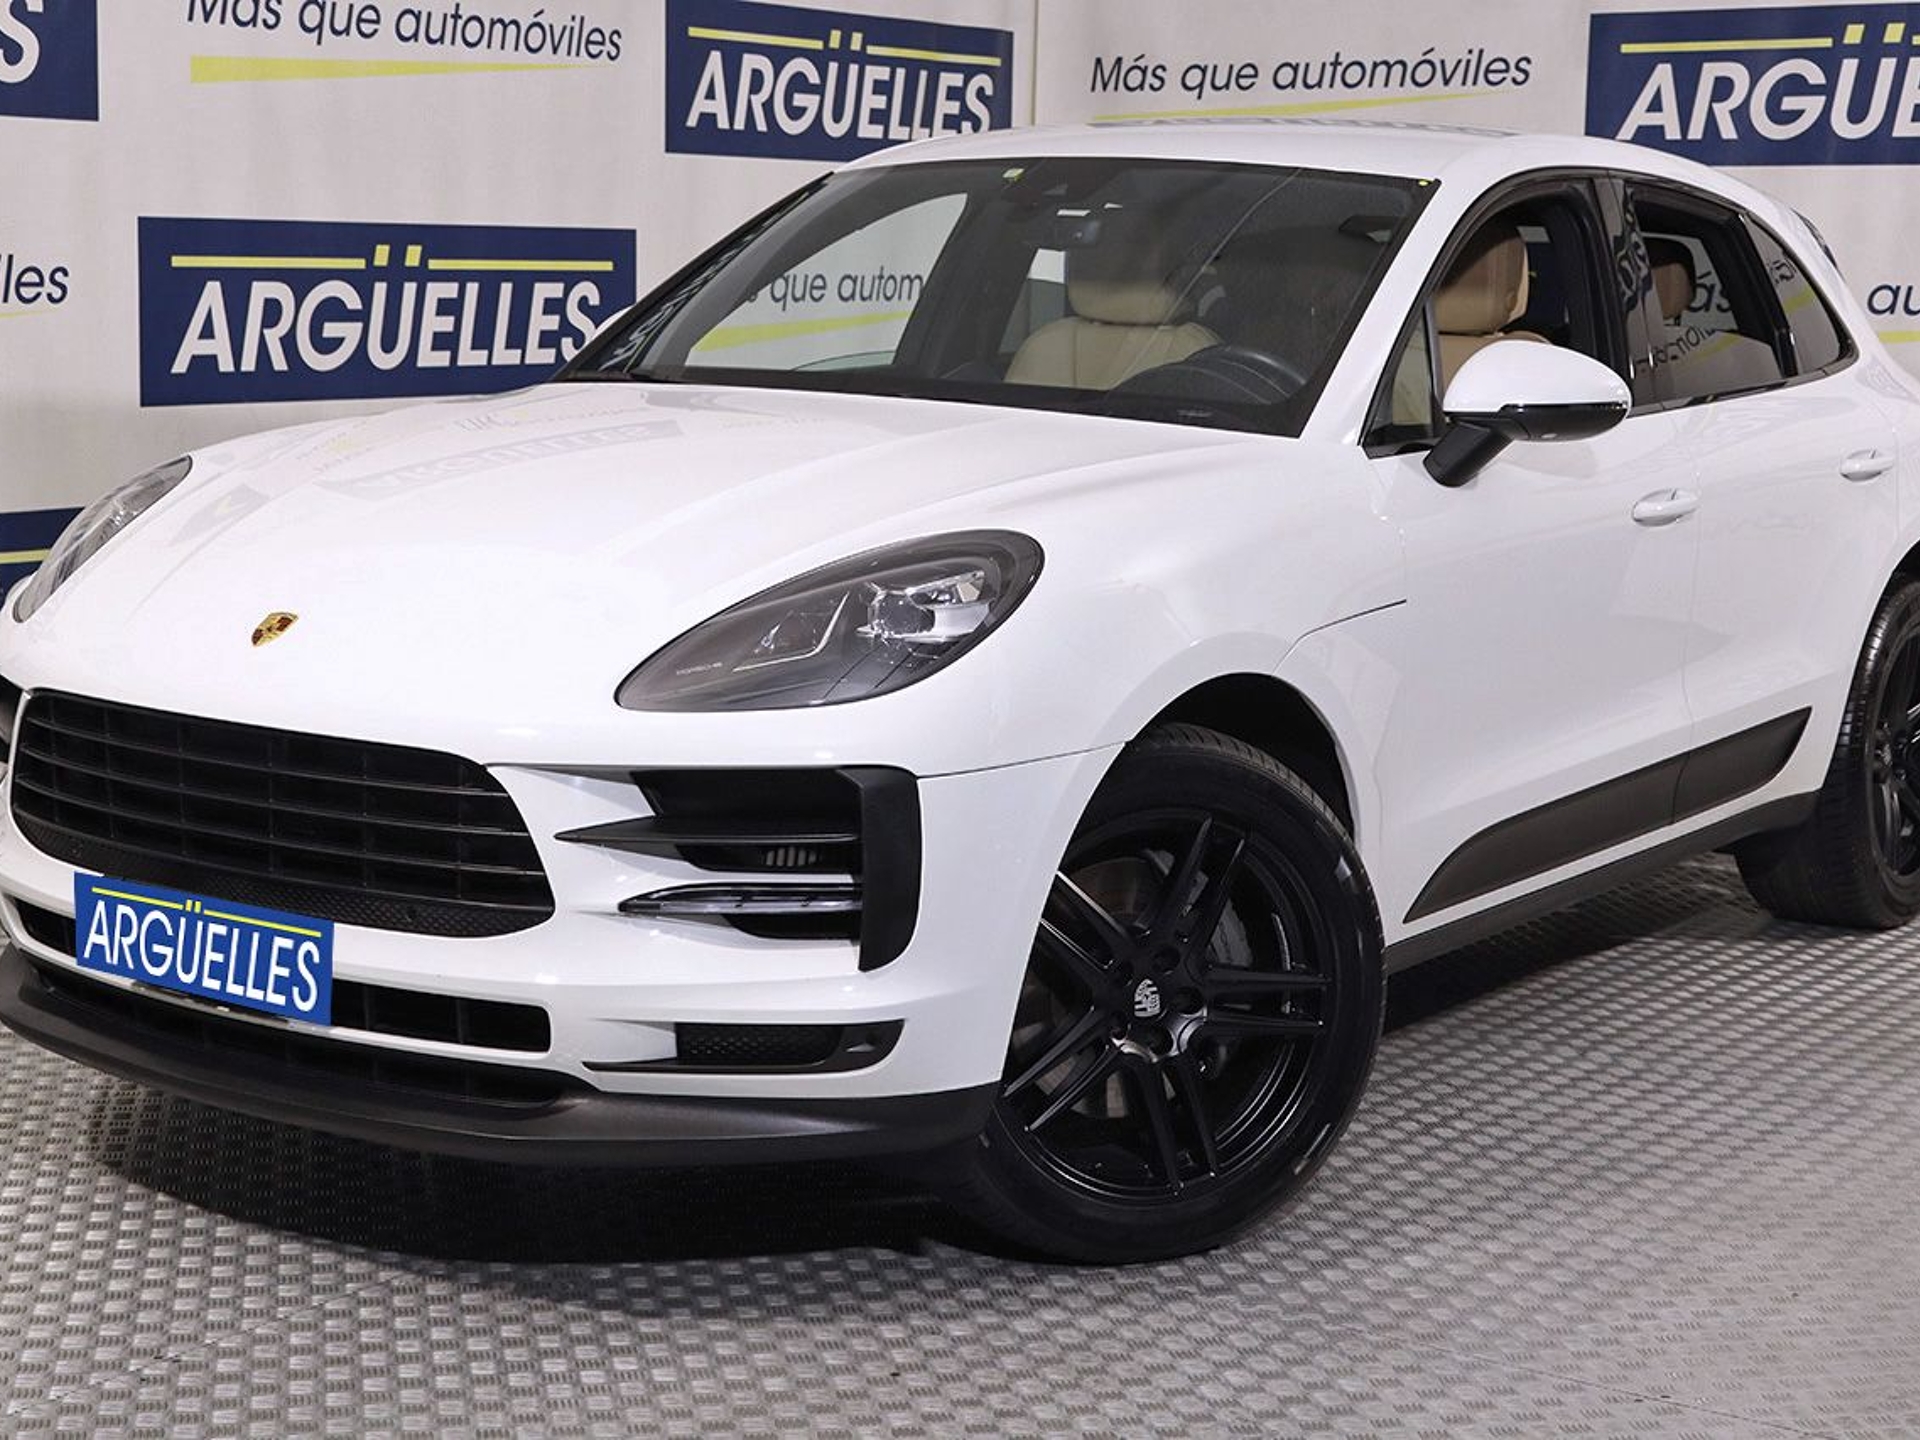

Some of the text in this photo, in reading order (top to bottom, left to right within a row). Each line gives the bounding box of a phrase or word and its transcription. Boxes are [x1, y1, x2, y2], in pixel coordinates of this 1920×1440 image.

[299, 0, 381, 45] que
[394, 3, 622, 62] automóviles
[1090, 47, 1532, 101] Más que automóviles
[684, 28, 994, 142] ARGÜELLES
[170, 244, 601, 374] ARGÜELLES
[769, 272, 827, 312] que
[83, 898, 321, 1012] ARGÜELLES
